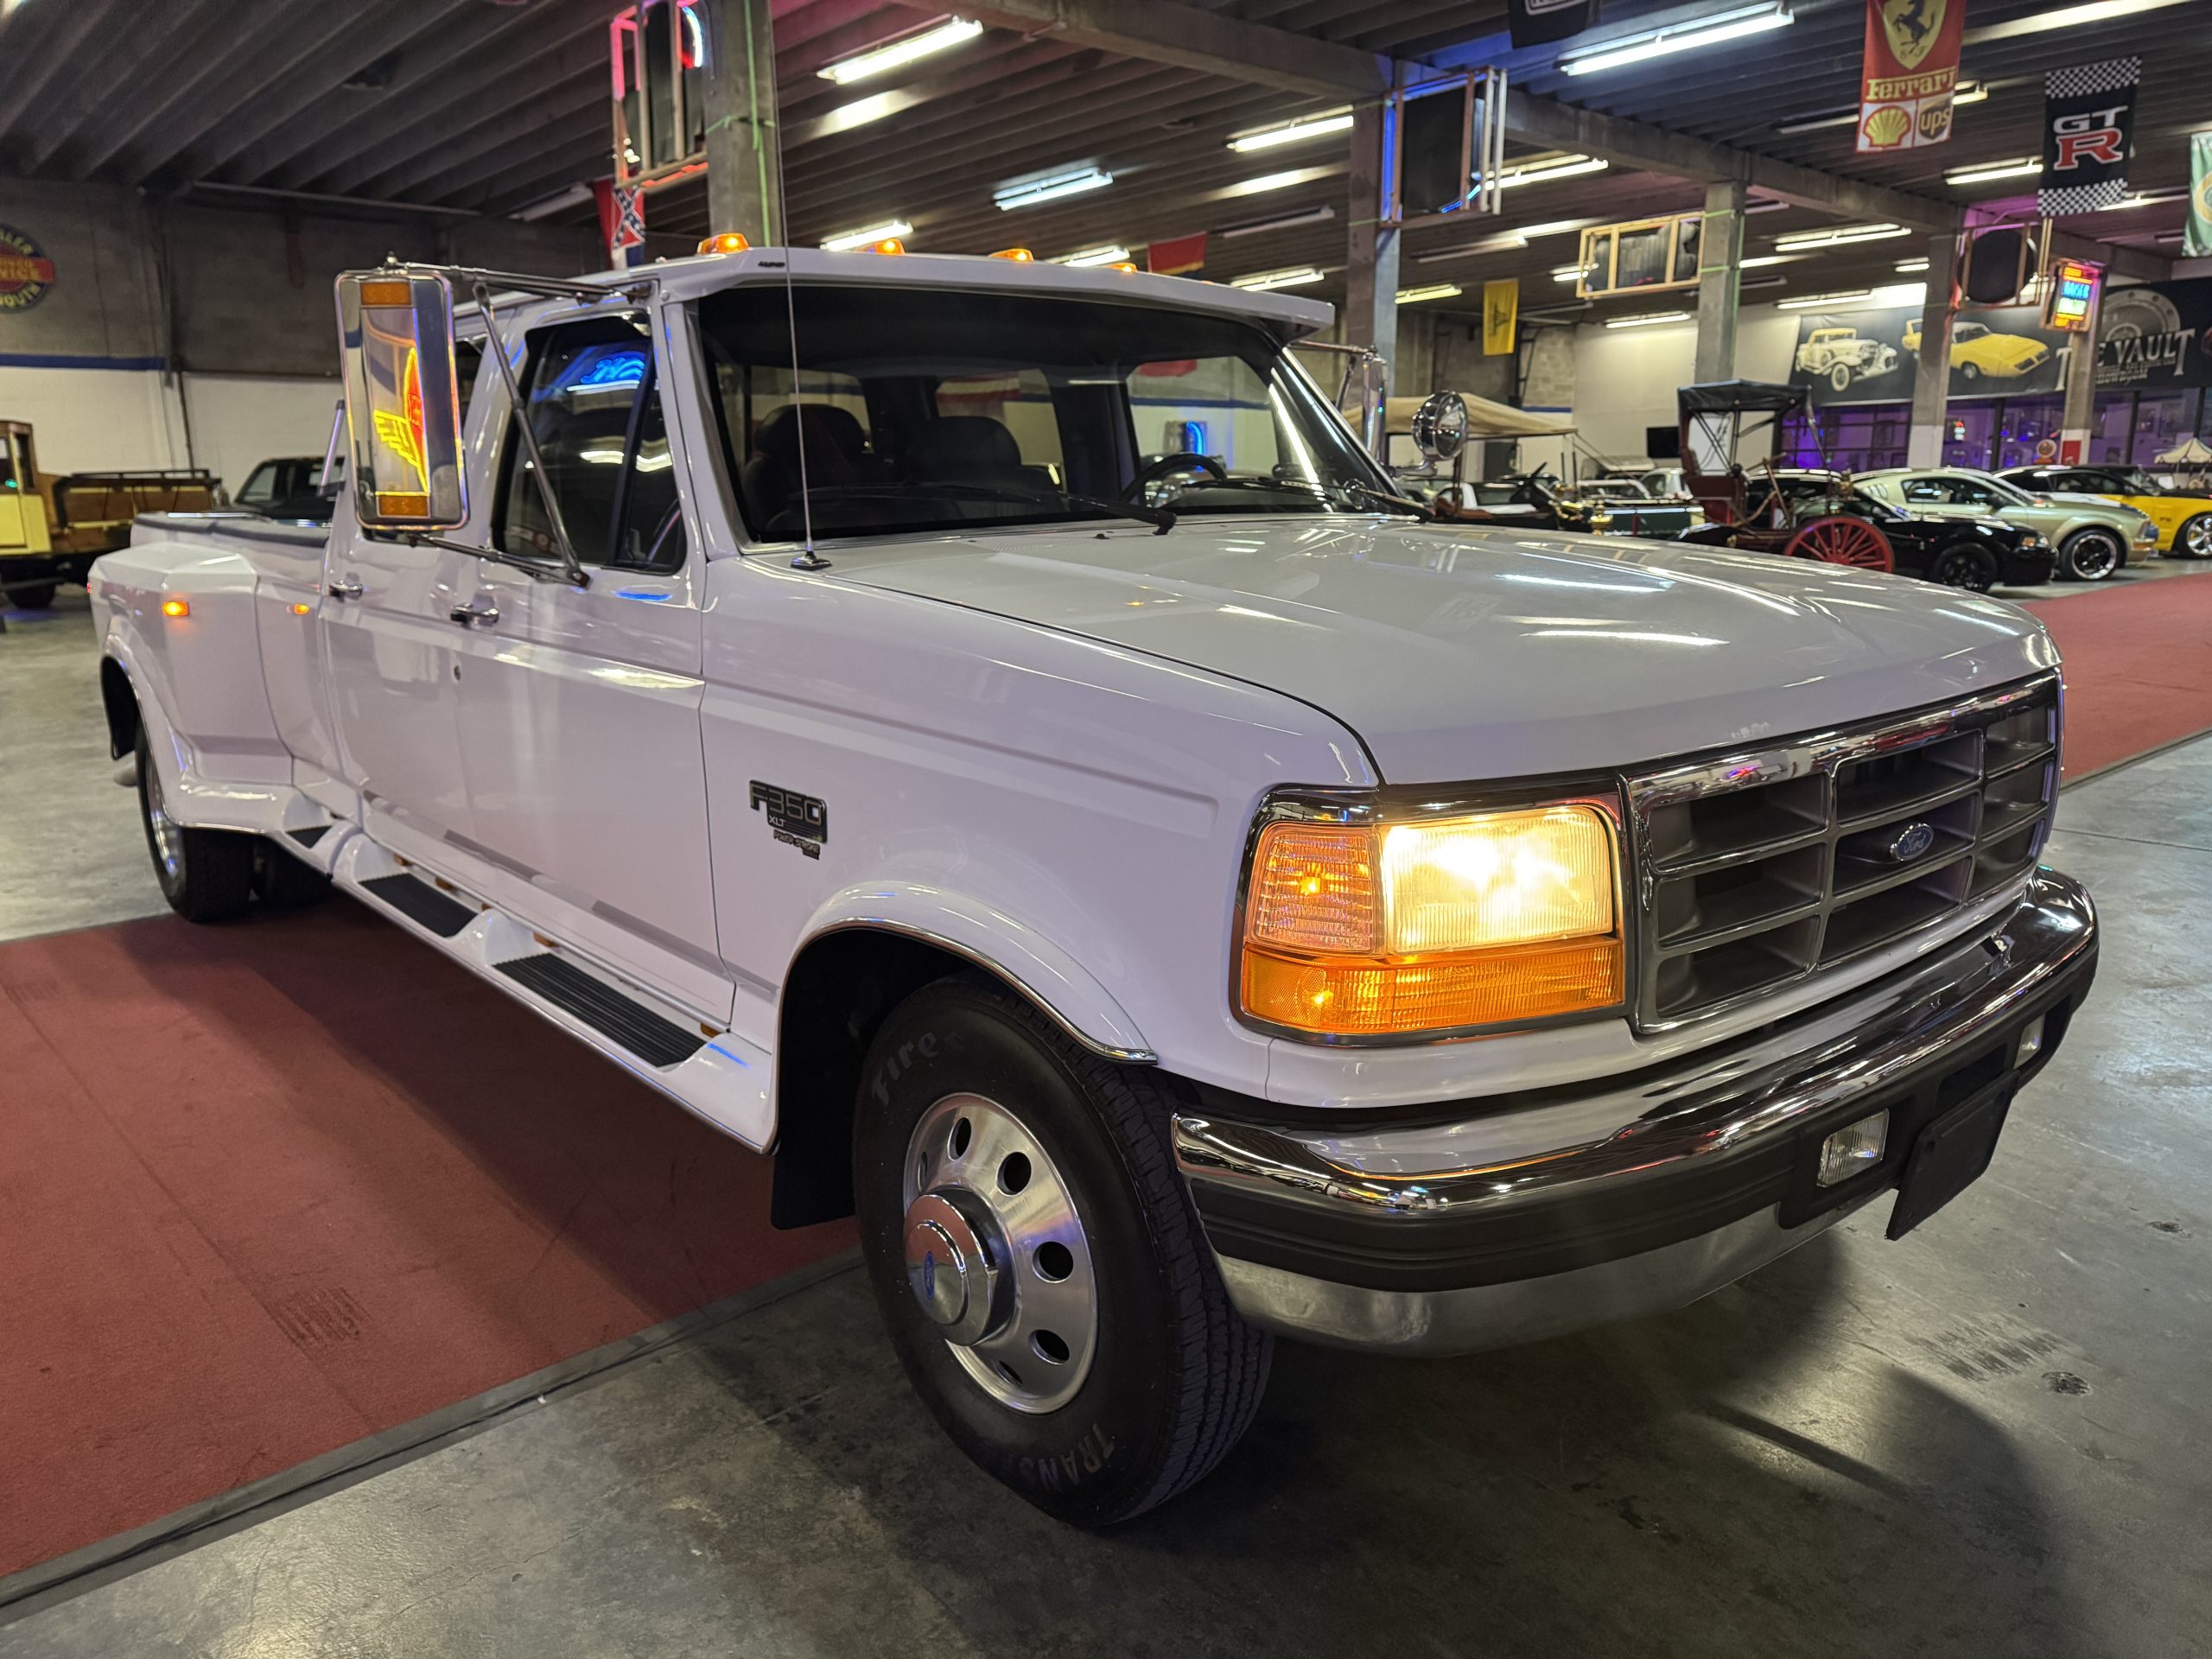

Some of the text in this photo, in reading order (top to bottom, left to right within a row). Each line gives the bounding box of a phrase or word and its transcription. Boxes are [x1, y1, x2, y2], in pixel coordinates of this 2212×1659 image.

[1866, 67, 1957, 101] Ferrari
[1920, 107, 1951, 136] ups
[2053, 105, 2129, 134] GT
[2053, 127, 2124, 171] R
[2054, 327, 2196, 391] TE VAULT
[750, 782, 823, 827] F350
[768, 815, 786, 828] XLT
